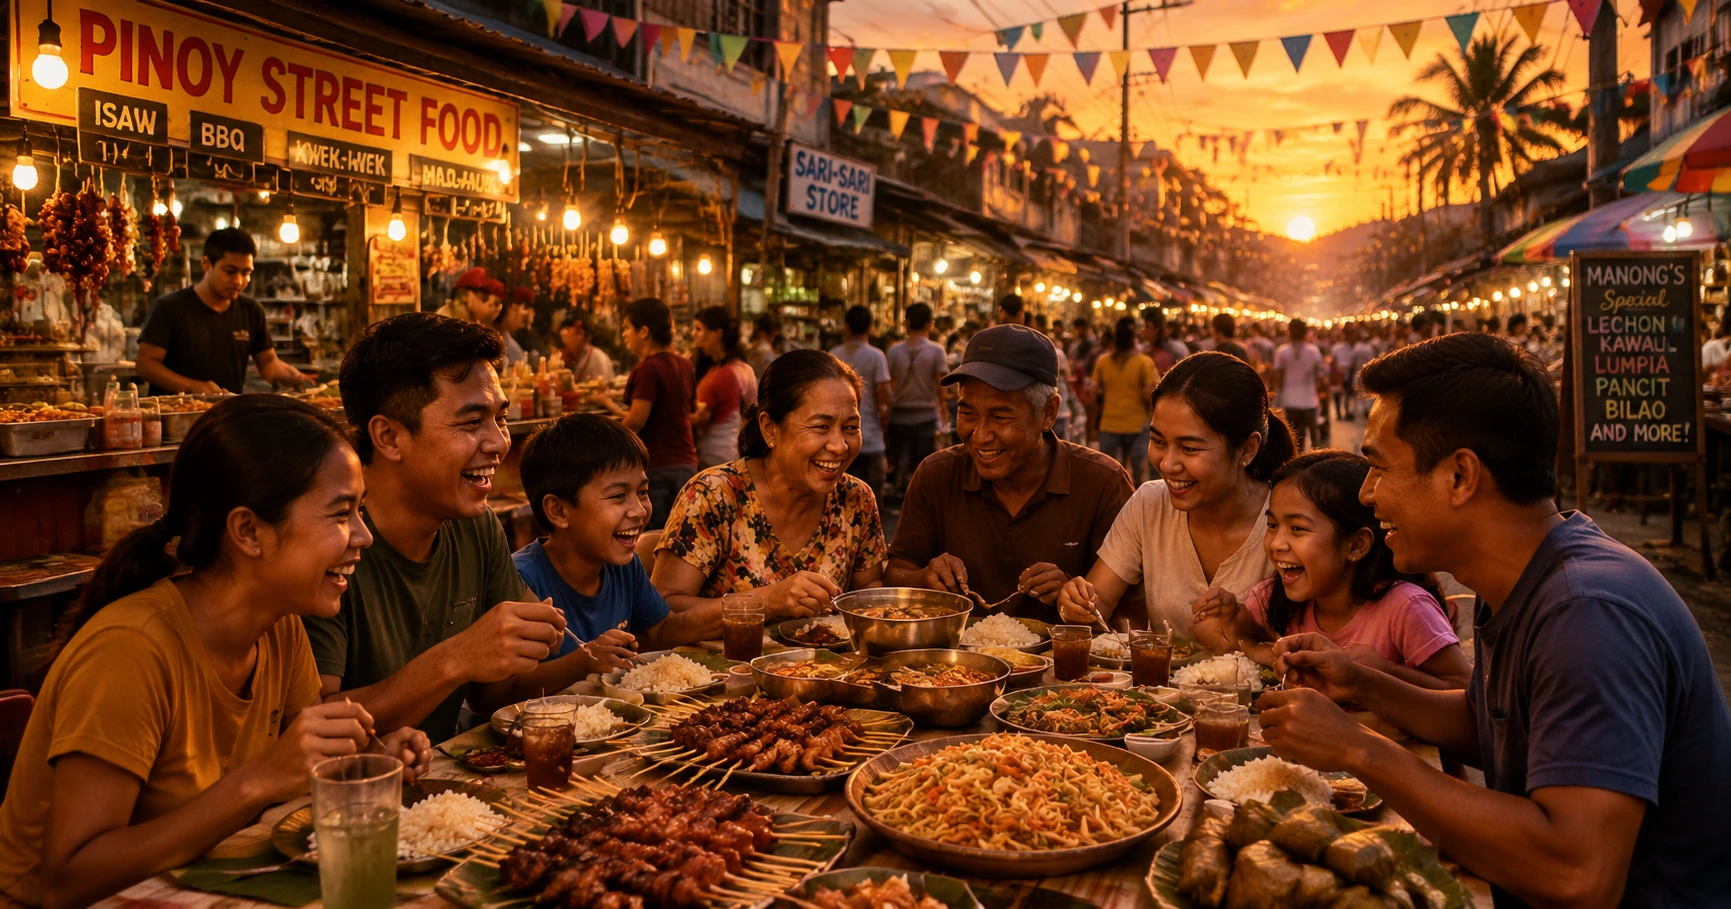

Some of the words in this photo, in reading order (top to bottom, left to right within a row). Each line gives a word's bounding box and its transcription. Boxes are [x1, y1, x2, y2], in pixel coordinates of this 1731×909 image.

[79, 8, 245, 104] PINOY
[260, 56, 408, 140] STREET
[420, 96, 502, 158] FOOD
[94, 100, 157, 136] ISAW
[201, 122, 245, 152] BBQ
[795, 150, 870, 196] SARI-SARI
[806, 184, 859, 220] STORE
[1586, 263, 1686, 287] MANONG'S
[1587, 315, 1666, 334] LECHON
[1595, 355, 1670, 375] LUMPIA
[1595, 377, 1671, 397] PANCIT
[1605, 399, 1666, 420] BILAO
[1590, 423, 1627, 442] AND
[1633, 422, 1691, 443] MORE!
